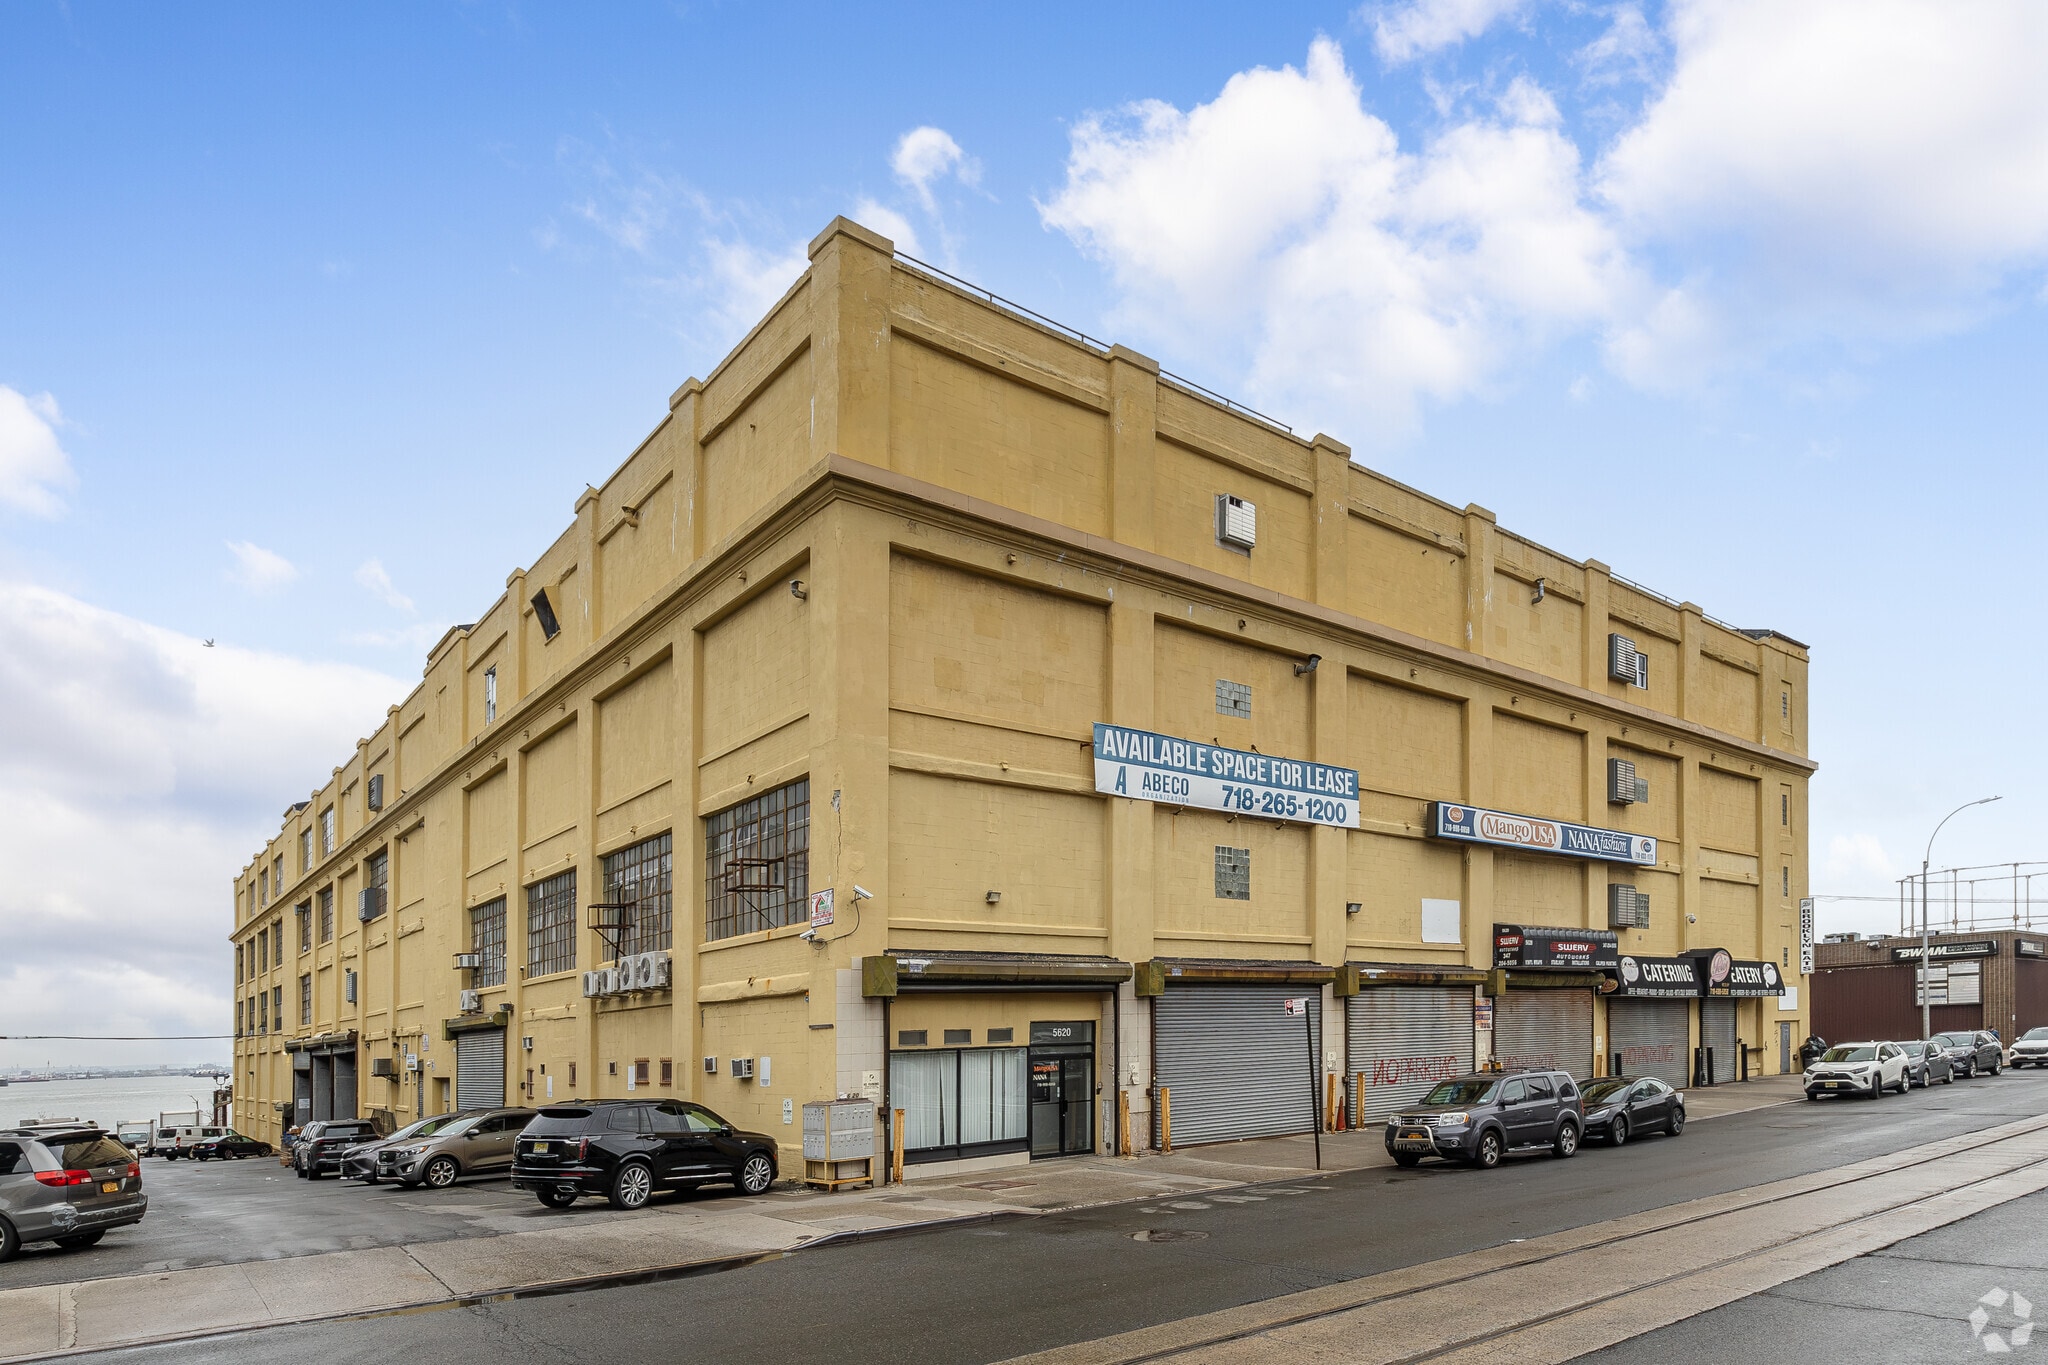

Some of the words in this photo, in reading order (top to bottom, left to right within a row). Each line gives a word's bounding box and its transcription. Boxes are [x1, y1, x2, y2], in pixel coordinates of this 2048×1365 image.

[1102, 729, 1207, 772] AVAILABLE
[1212, 750, 1267, 782] SPACE
[1271, 761, 1302, 787] FOR
[1306, 766, 1354, 795] LEASE
[1142, 771, 1190, 796] ABECO
[1141, 791, 1189, 803] ORGANIZATION
[1222, 784, 1347, 824] 718-265-1200
[1485, 817, 1530, 843] Mango
[1531, 824, 1557, 845] USA
[1568, 829, 1600, 850] NANA
[1598, 833, 1627, 854] fashion
[1802, 908, 1811, 948] BROOKLYN
[1499, 937, 1519, 946] SWERV
[1557, 943, 1589, 951] SWERV
[1802, 950, 1812, 971] EATS
[1642, 963, 1694, 982] CATERING
[1731, 967, 1762, 983] EATERY
[1052, 1027, 1071, 1037] 5620
[1373, 1059, 1399, 1087] NO
[1400, 1056, 1458, 1085] PARKING
